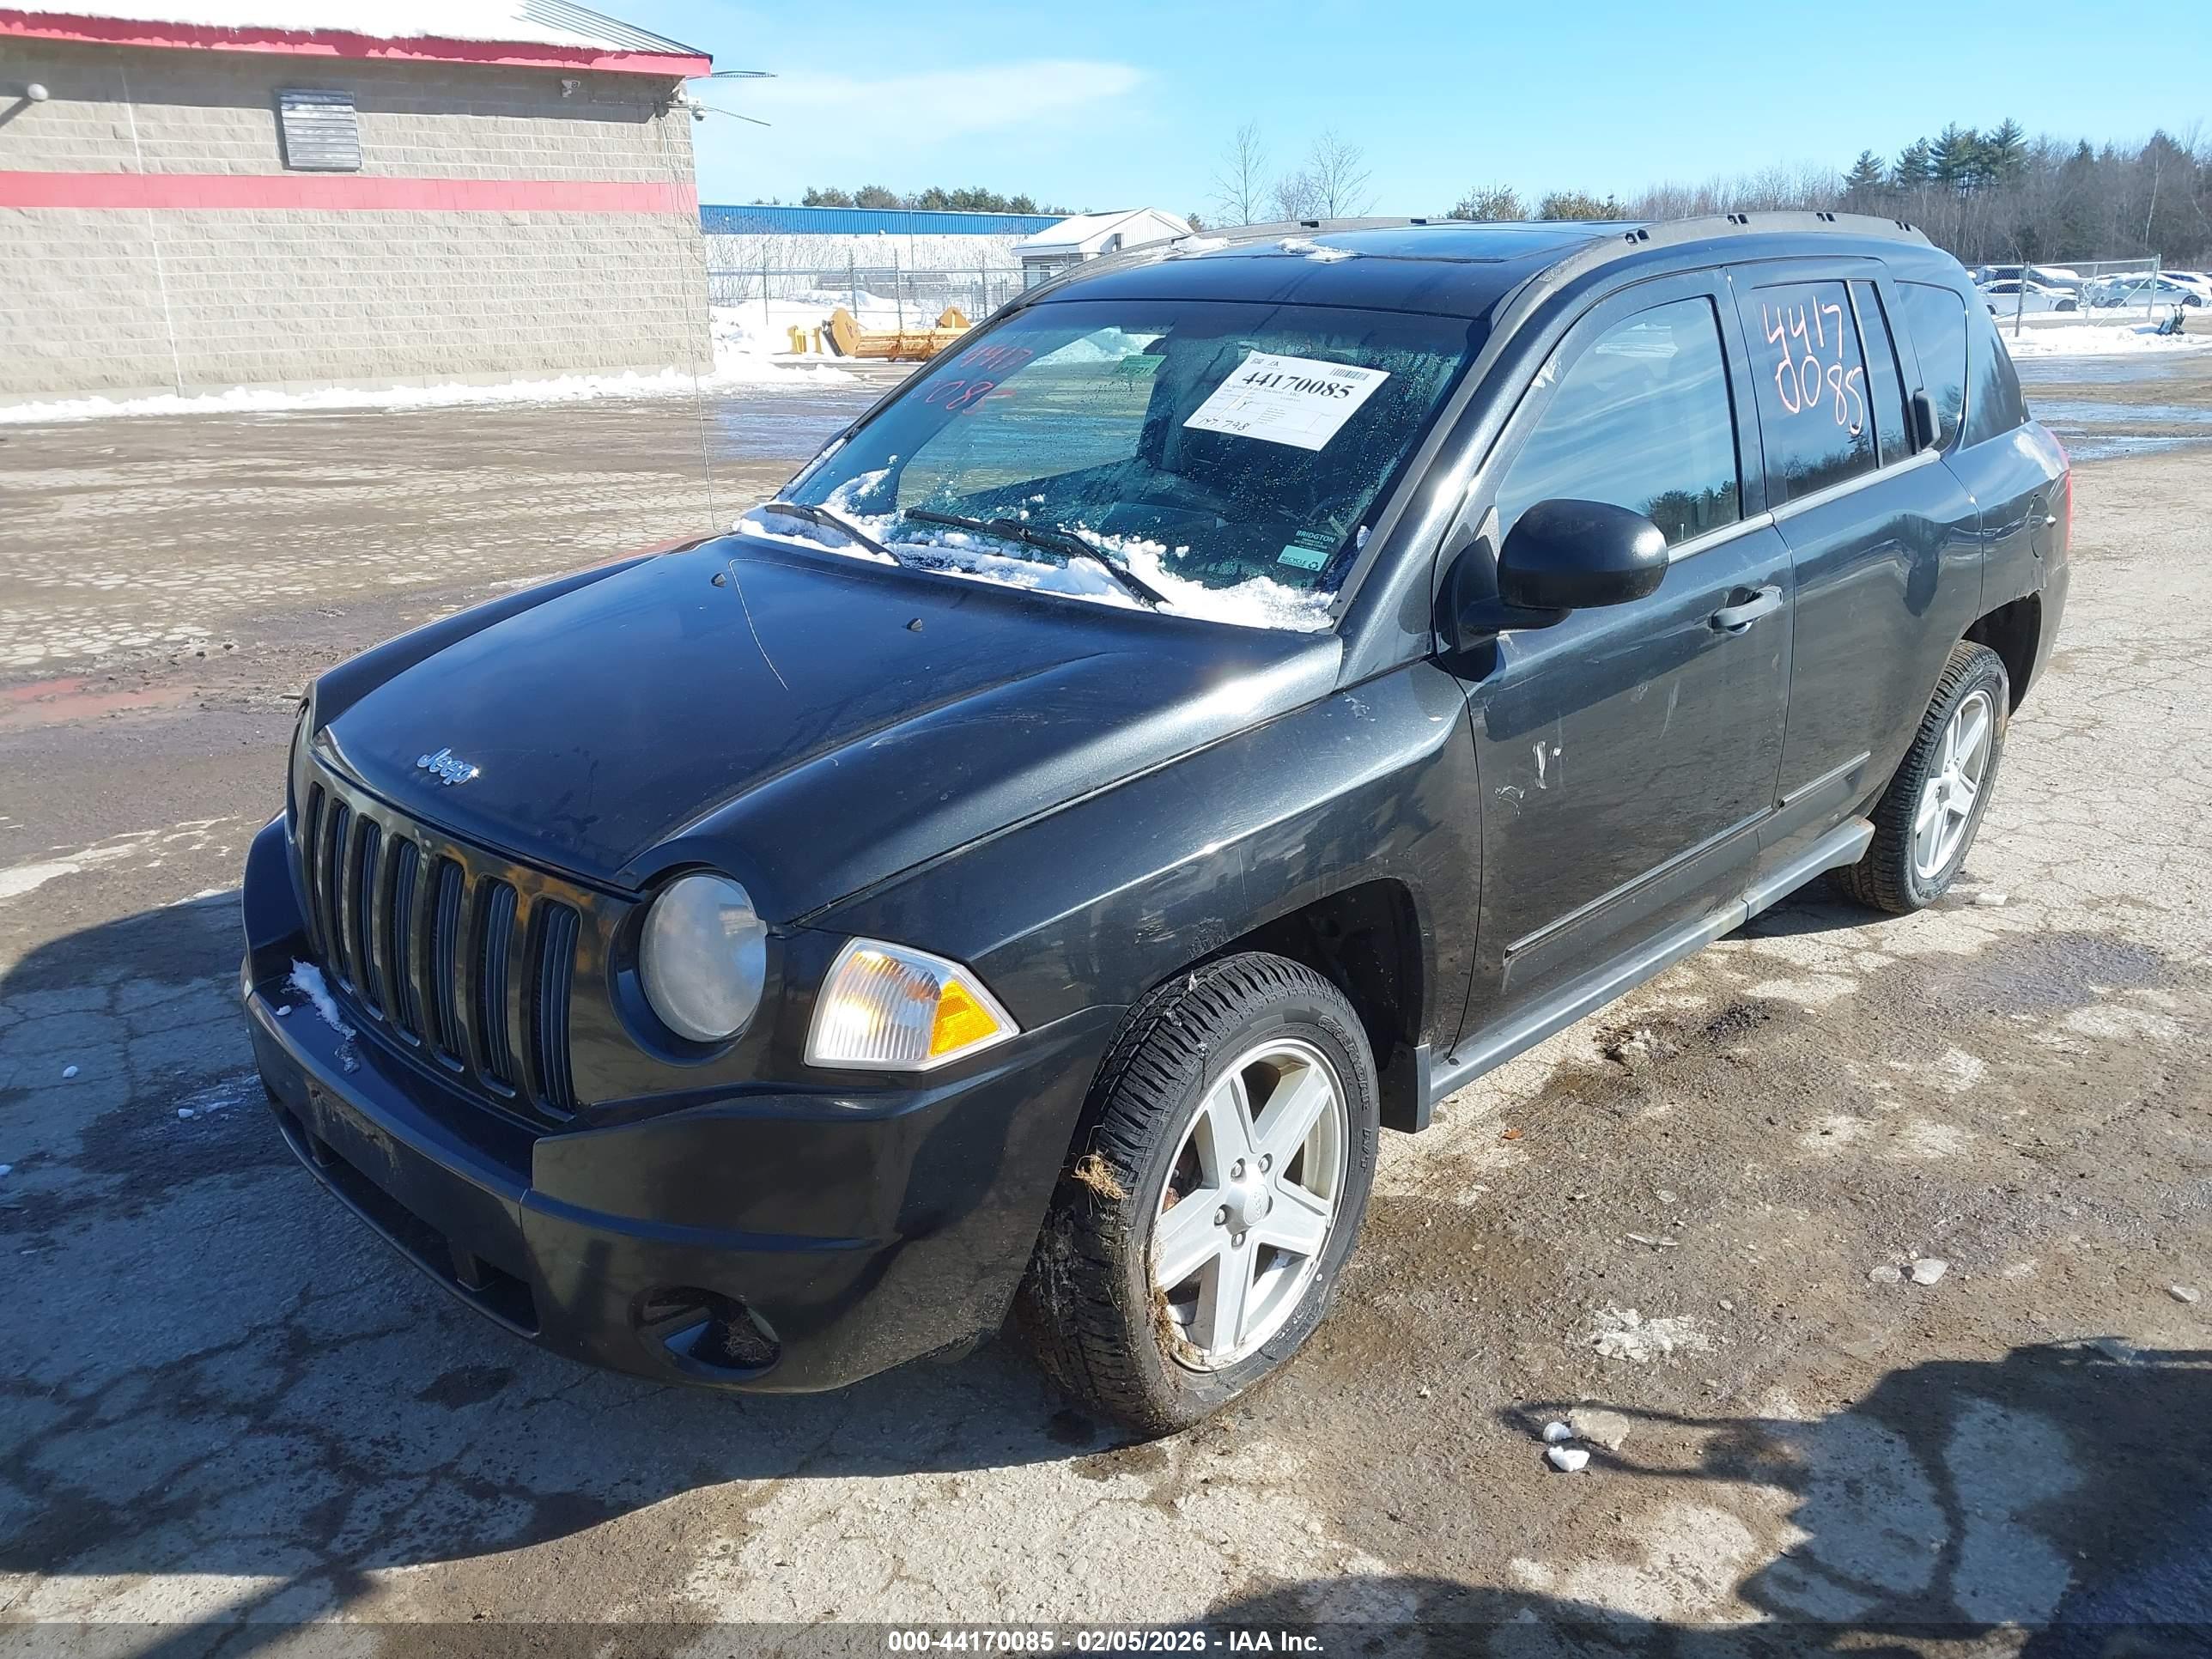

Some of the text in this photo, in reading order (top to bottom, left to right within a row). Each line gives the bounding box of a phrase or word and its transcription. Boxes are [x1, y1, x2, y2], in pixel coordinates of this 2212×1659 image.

[1762, 295, 1843, 359] 4417
[1242, 371, 1355, 399] 44170085
[1775, 355, 1863, 436] 0085
[1296, 530, 1335, 543] BRIDGTON
[416, 747, 479, 786] Jeep
